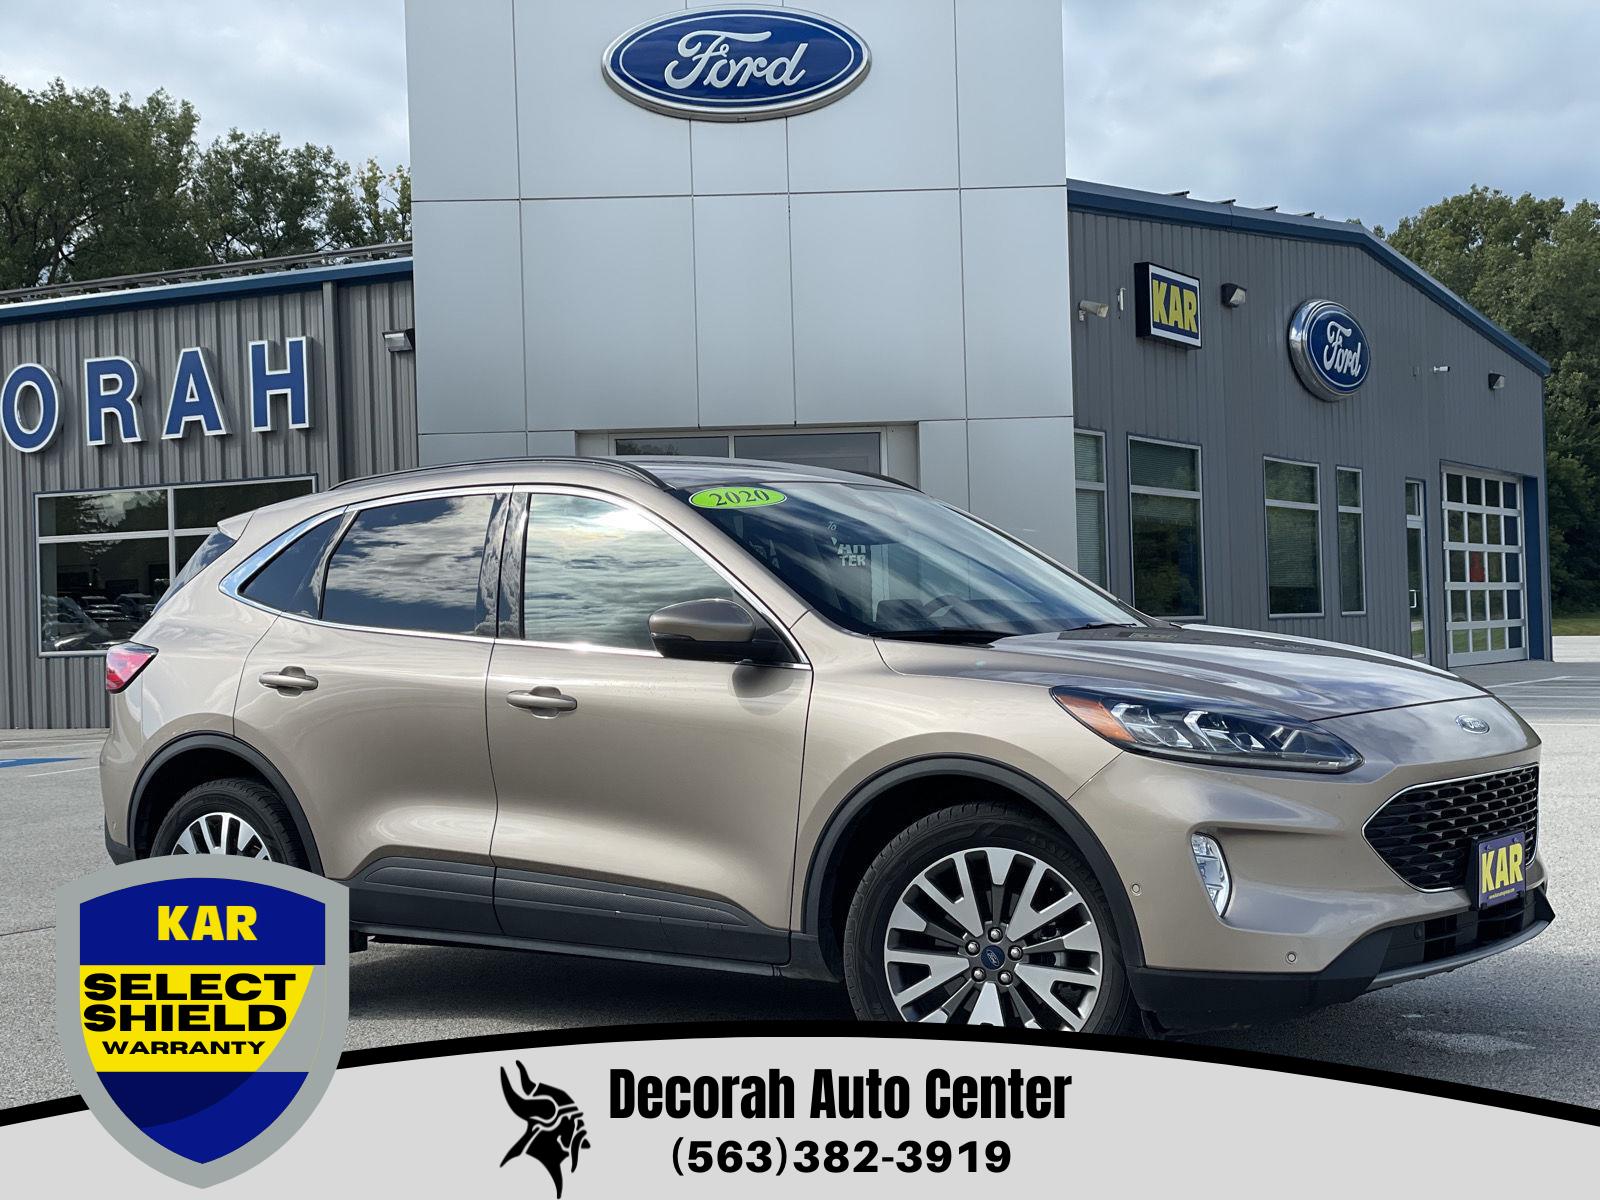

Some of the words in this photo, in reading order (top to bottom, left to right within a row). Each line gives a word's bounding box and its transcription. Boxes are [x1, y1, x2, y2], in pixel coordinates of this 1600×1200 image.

[664, 30, 808, 89] Ford
[1152, 279, 1198, 333] KAR
[1323, 321, 1362, 377] Ford
[0, 336, 312, 453] ORAH
[709, 489, 770, 506] 2020
[1481, 842, 1524, 894] KAR
